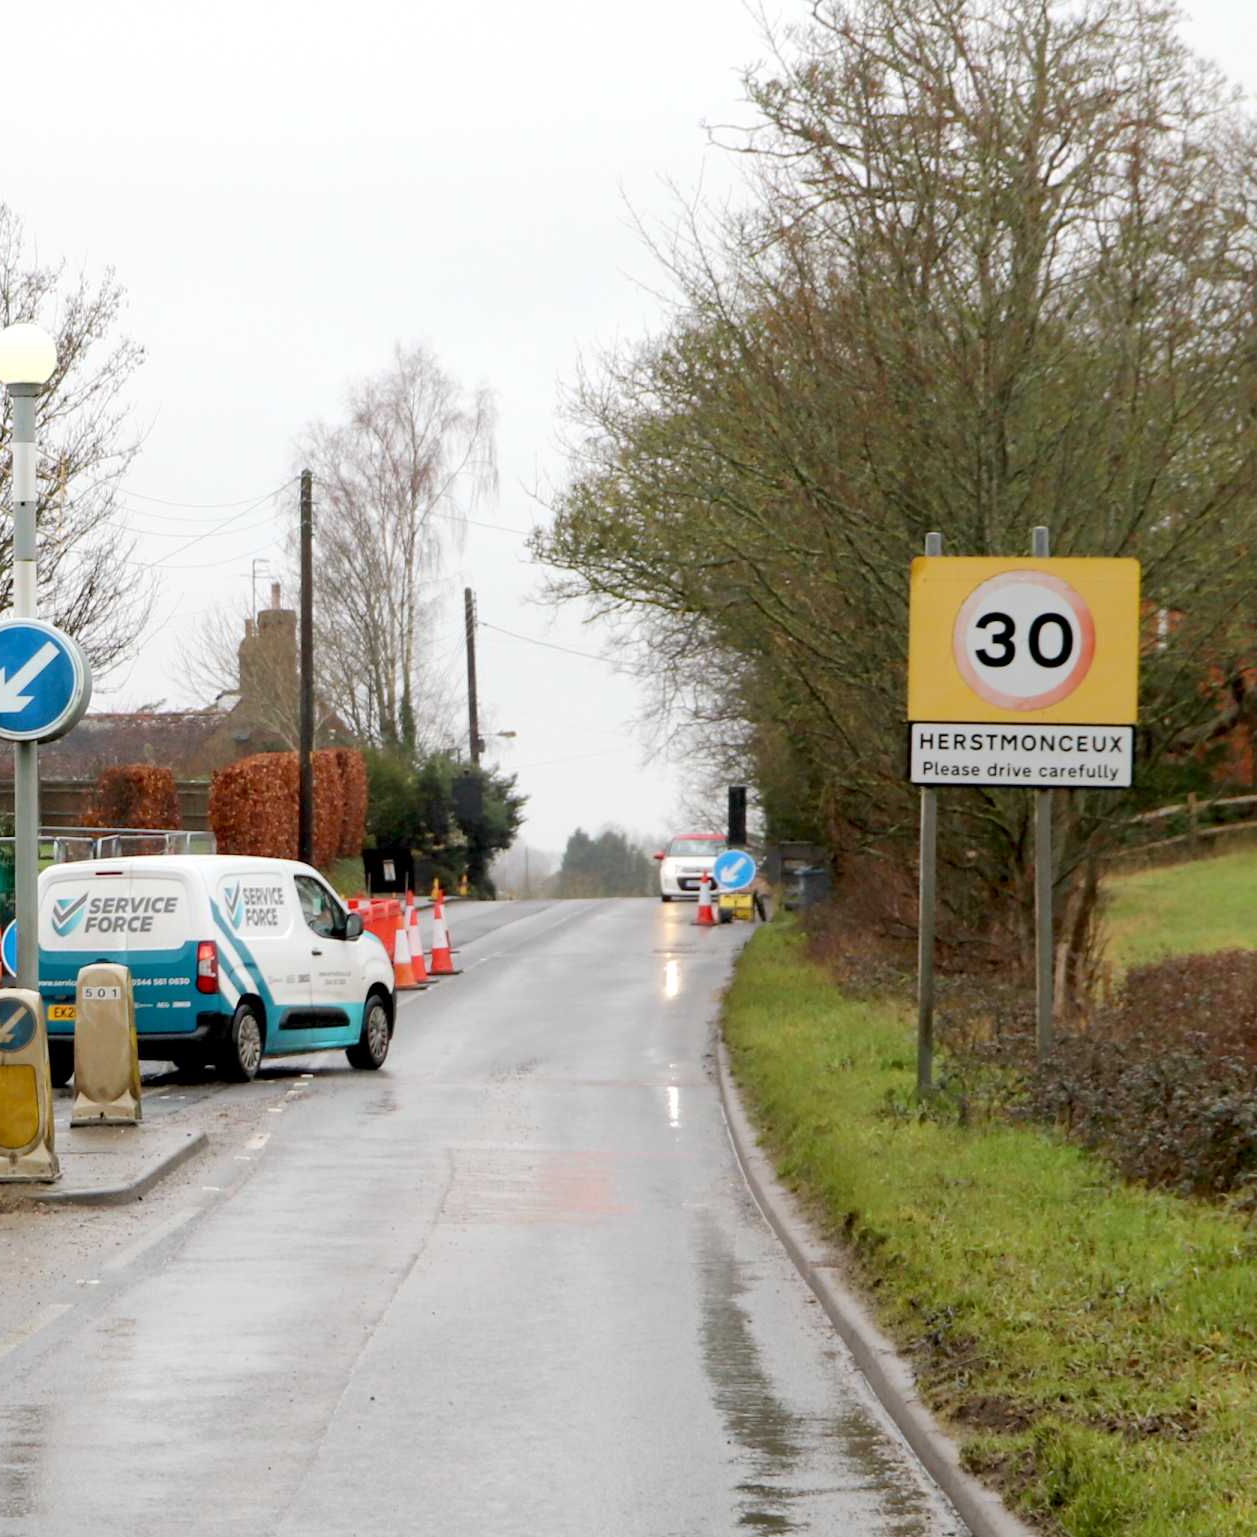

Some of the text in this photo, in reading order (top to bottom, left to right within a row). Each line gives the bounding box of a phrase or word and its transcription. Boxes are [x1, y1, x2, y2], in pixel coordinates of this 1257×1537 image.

[975, 611, 1073, 668] 30
[920, 733, 1123, 753] HERSTMONCEUX
[923, 761, 1119, 782] Please drive carefully
[89, 897, 178, 914] SERVICE
[243, 887, 284, 906] SERVICE
[84, 916, 154, 933] FORCE
[246, 908, 278, 926] FORCE
